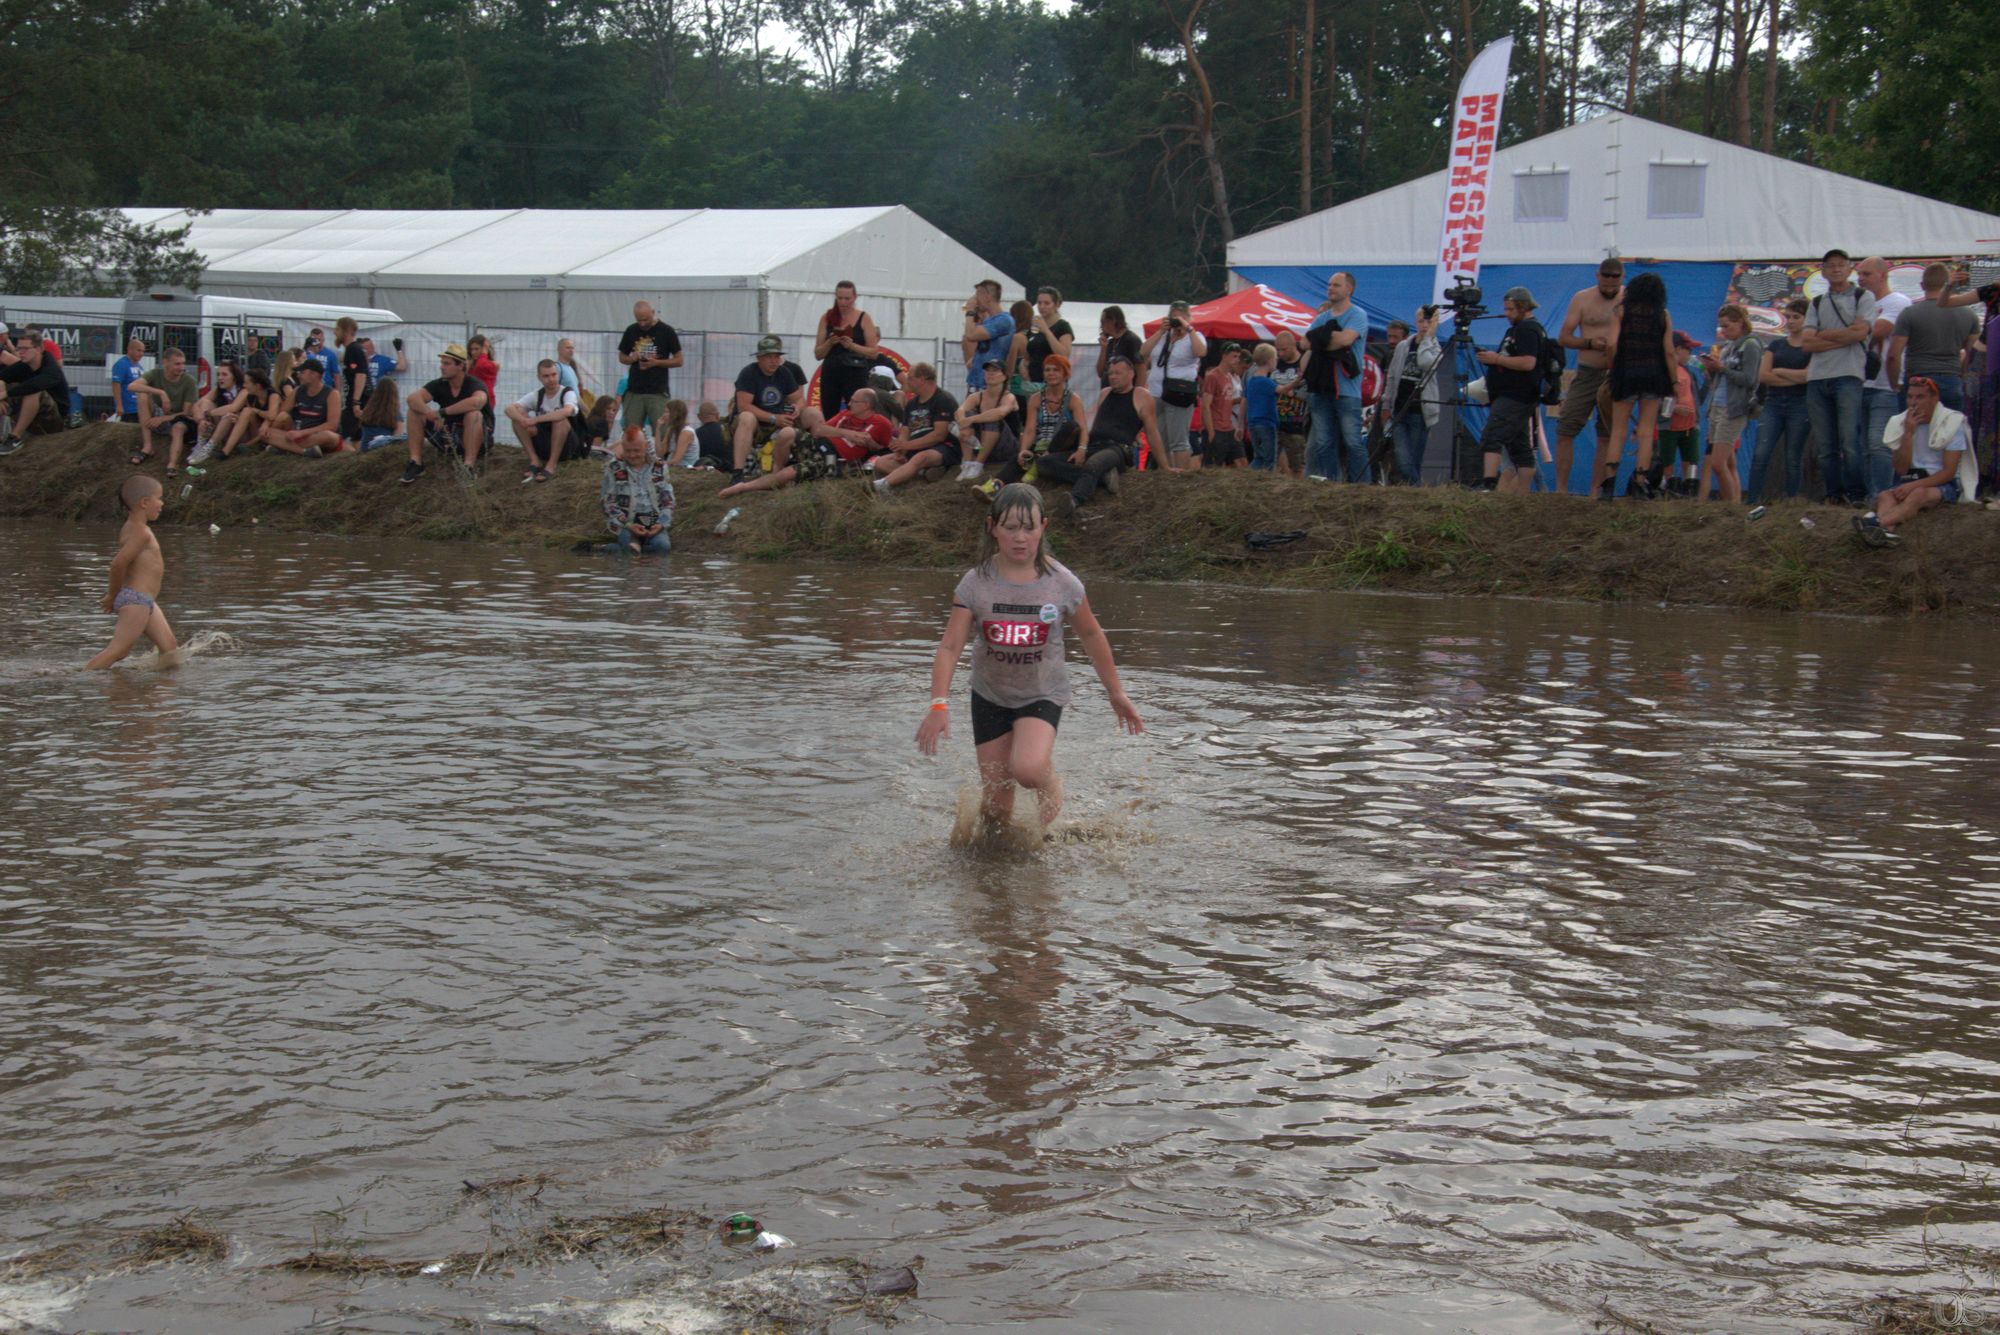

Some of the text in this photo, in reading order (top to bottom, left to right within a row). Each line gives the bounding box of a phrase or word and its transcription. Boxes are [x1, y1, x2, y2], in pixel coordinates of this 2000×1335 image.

[1446, 95, 1480, 235] PATROL
[1459, 93, 1499, 272] MEDYCZNY
[42, 328, 80, 345] ATM
[130, 326, 156, 341] ATM
[988, 623, 1043, 645] GIRL
[986, 646, 1042, 665] POWER
